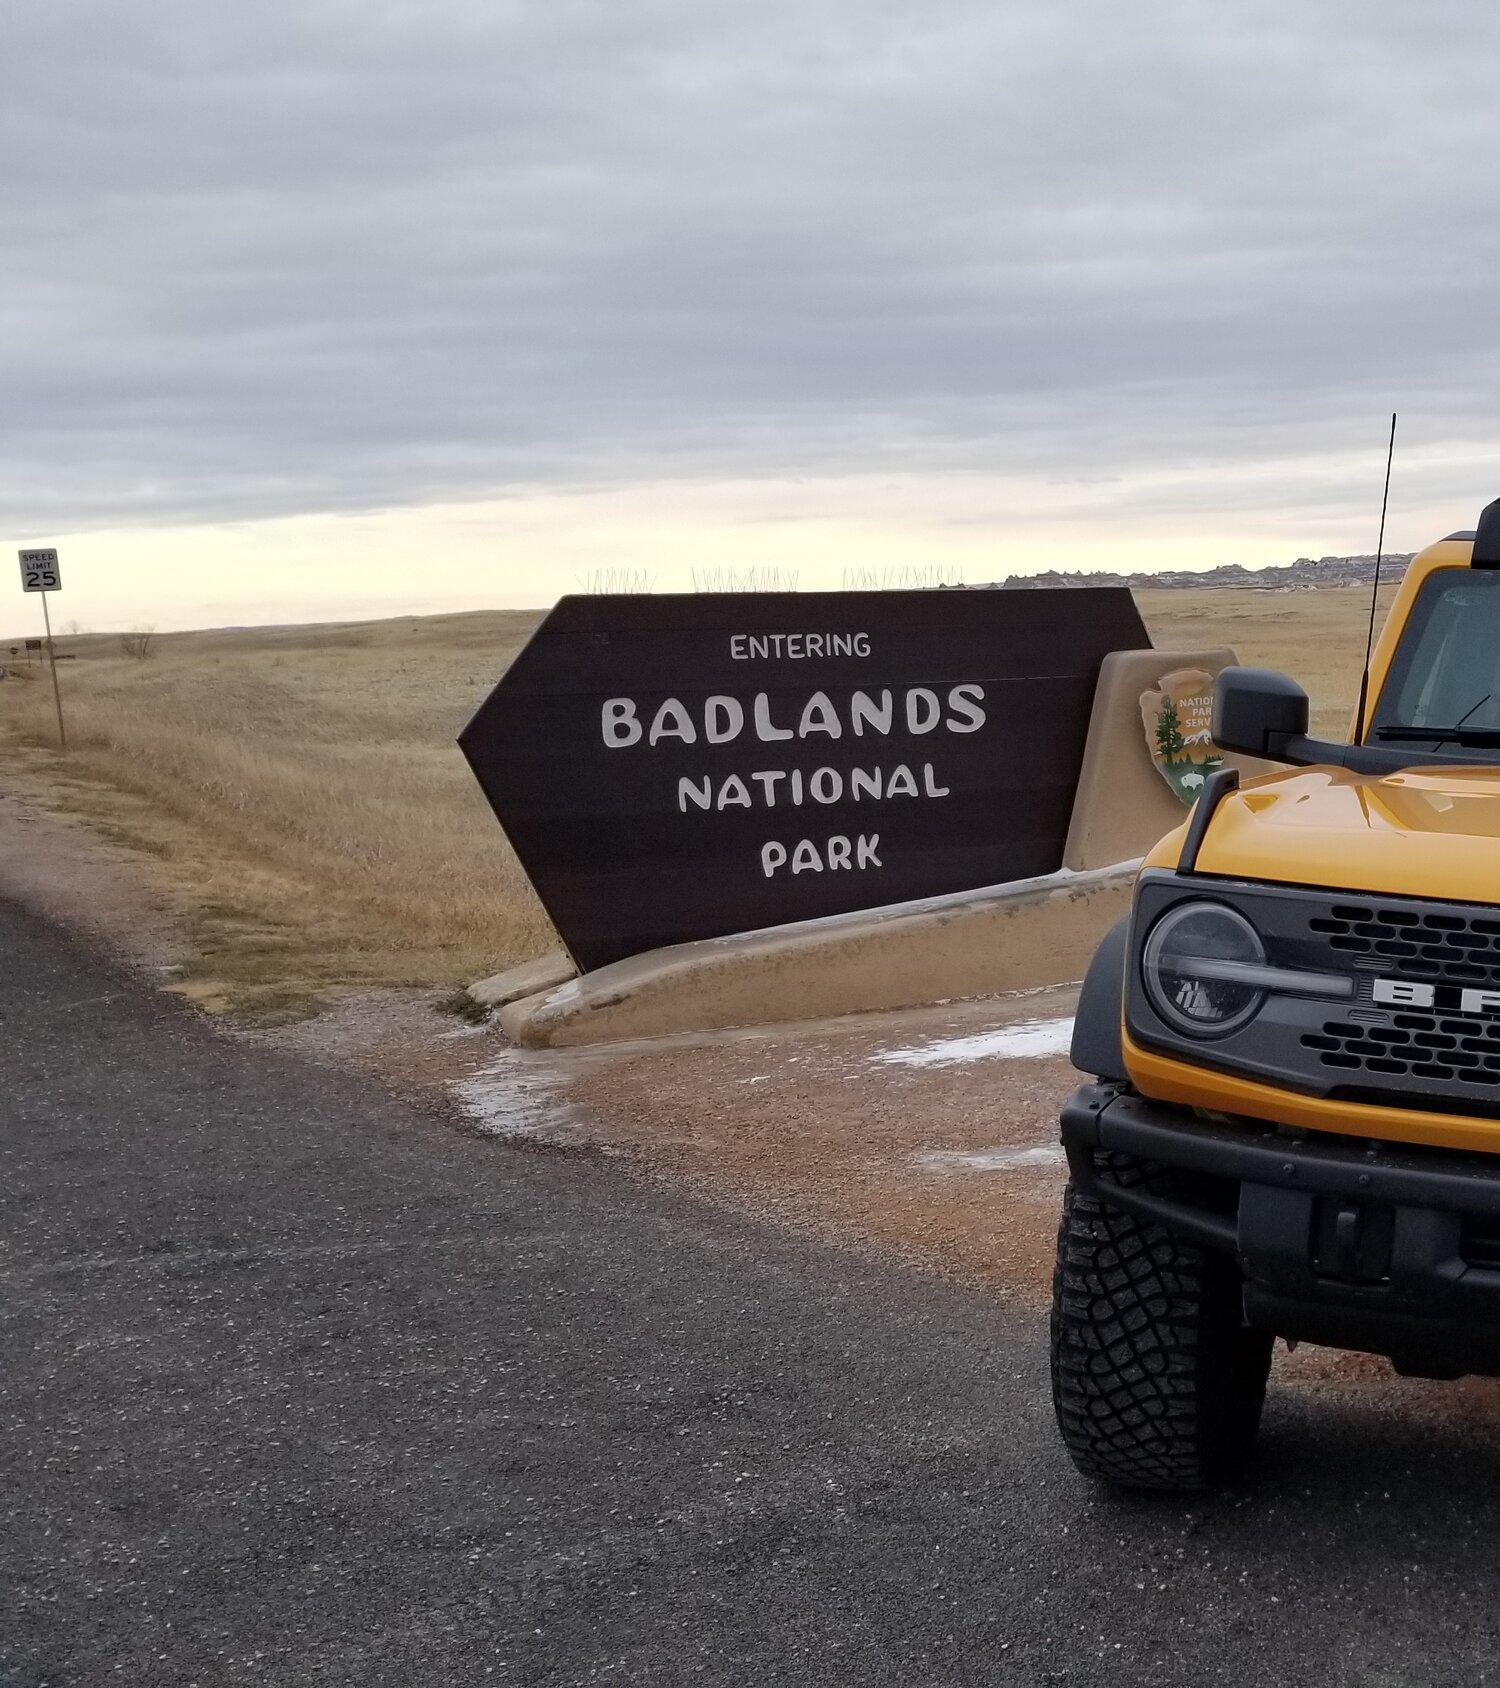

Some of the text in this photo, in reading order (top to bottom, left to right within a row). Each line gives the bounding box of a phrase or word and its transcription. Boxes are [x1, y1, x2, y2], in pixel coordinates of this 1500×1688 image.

[23, 553, 54, 561] SPEED
[27, 562, 50, 570] LIMIT
[26, 571, 56, 587] 25
[730, 632, 872, 660] ENTERING
[601, 684, 987, 748] BADLANDS
[678, 763, 950, 813] NATIONAL
[761, 834, 883, 878] PARK
